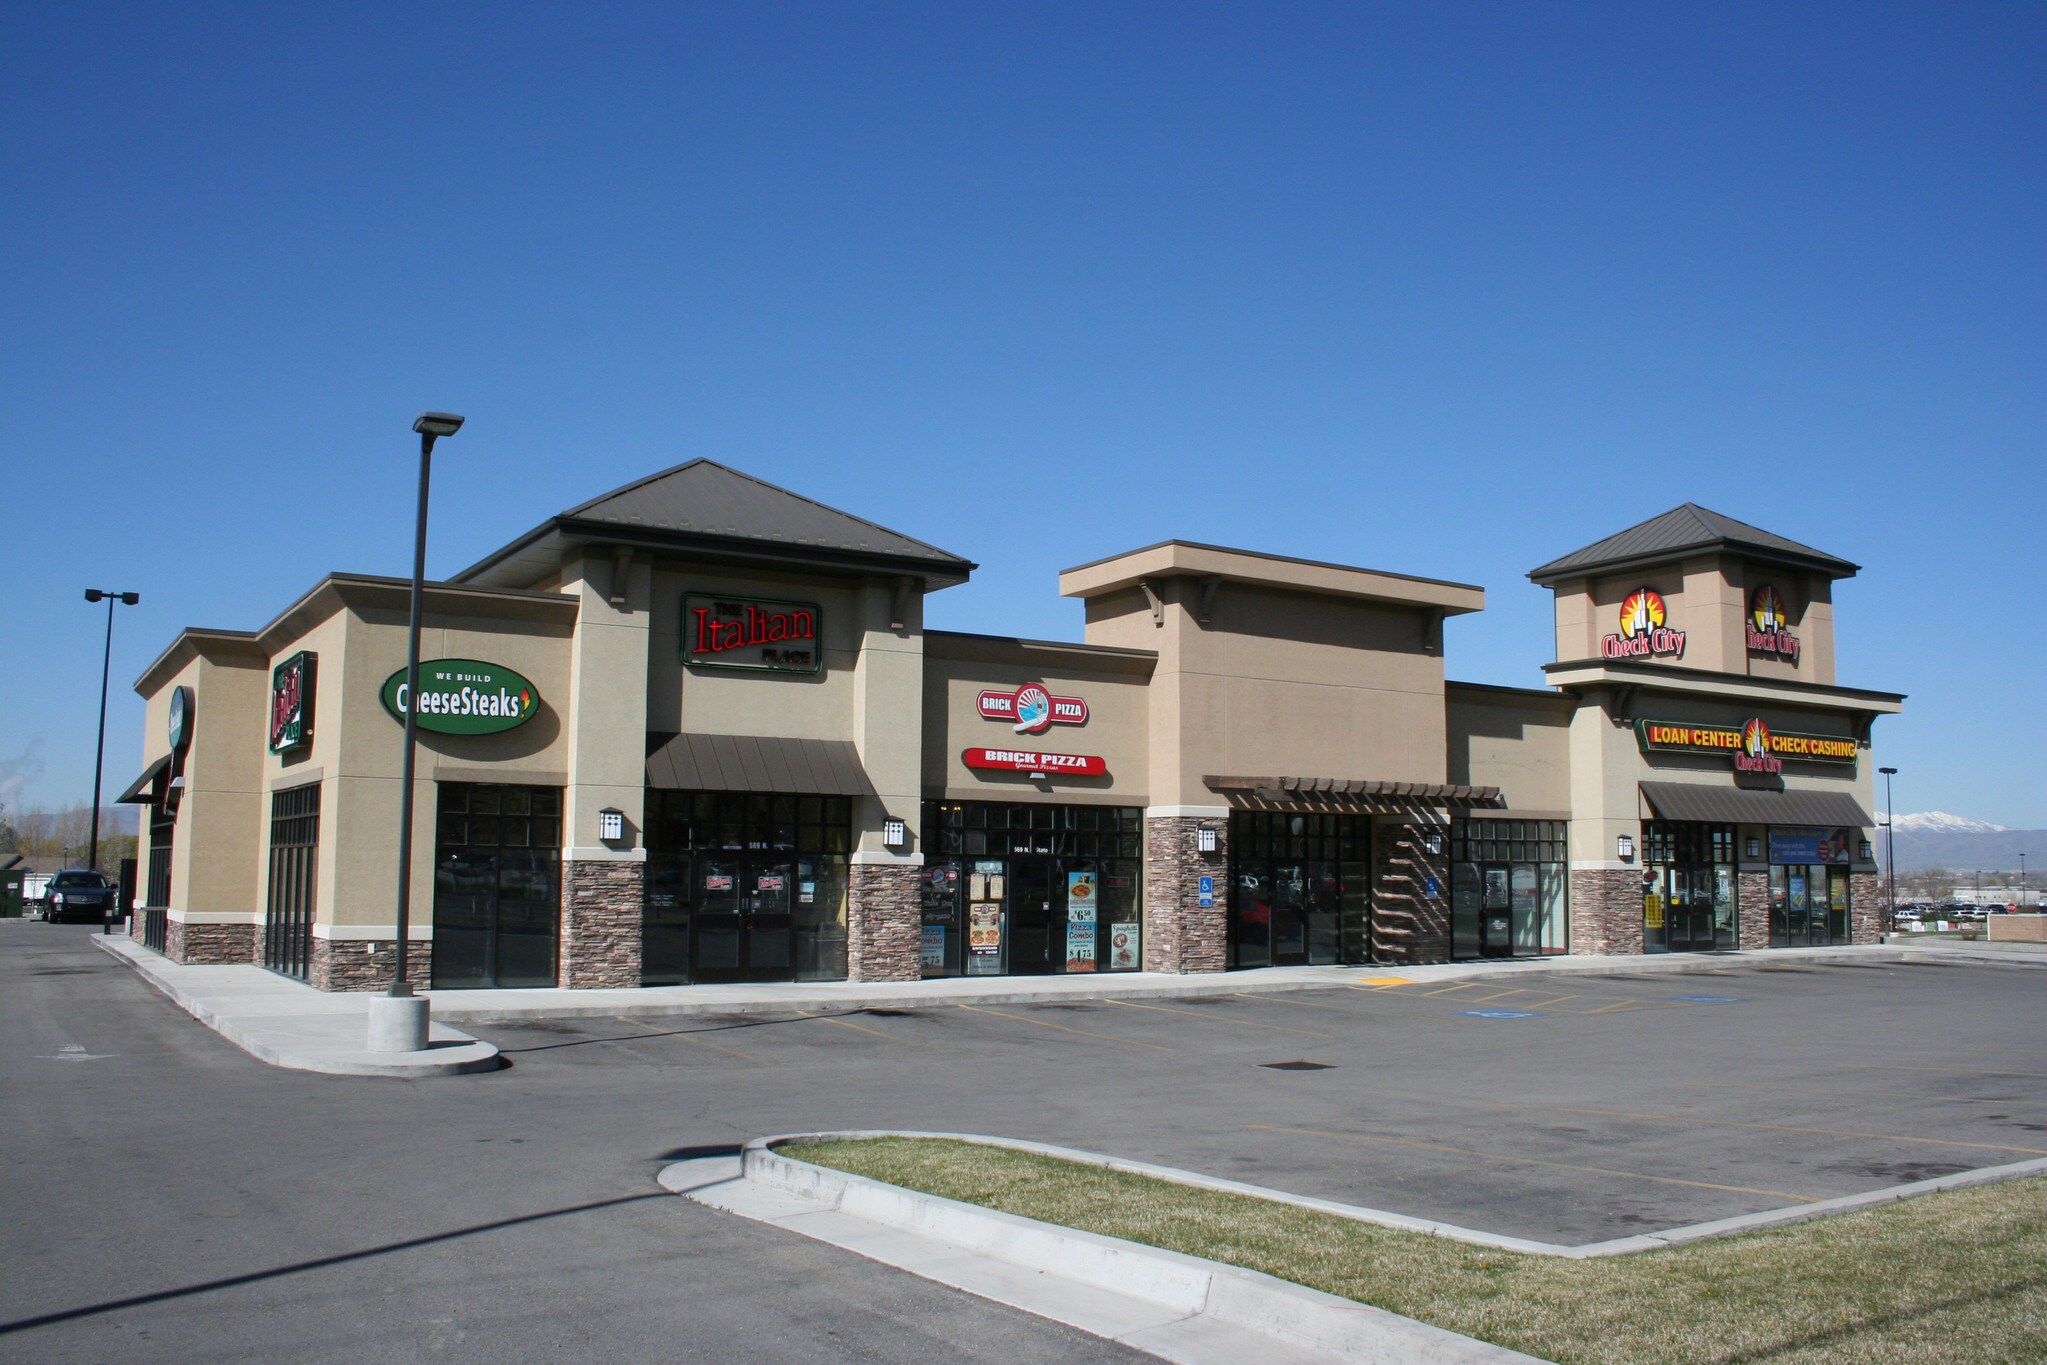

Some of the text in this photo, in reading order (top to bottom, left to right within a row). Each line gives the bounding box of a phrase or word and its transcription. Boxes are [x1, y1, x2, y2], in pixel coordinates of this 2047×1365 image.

[692, 604, 815, 653] Italian
[1602, 628, 1685, 659] Check City
[1747, 623, 1800, 659] heck City
[436, 672, 491, 683] WE BUILD
[396, 683, 519, 718] CeeseSteaks
[982, 697, 1082, 716] BRICK PIZZA
[1654, 726, 1856, 758] LOAN CENTER CHECK CASHING
[985, 750, 1087, 768] BRICK PIZZA
[1015, 762, 1038, 770] Gourmet
[1735, 752, 1782, 776] Check City
[921, 937, 943, 945] ombo
